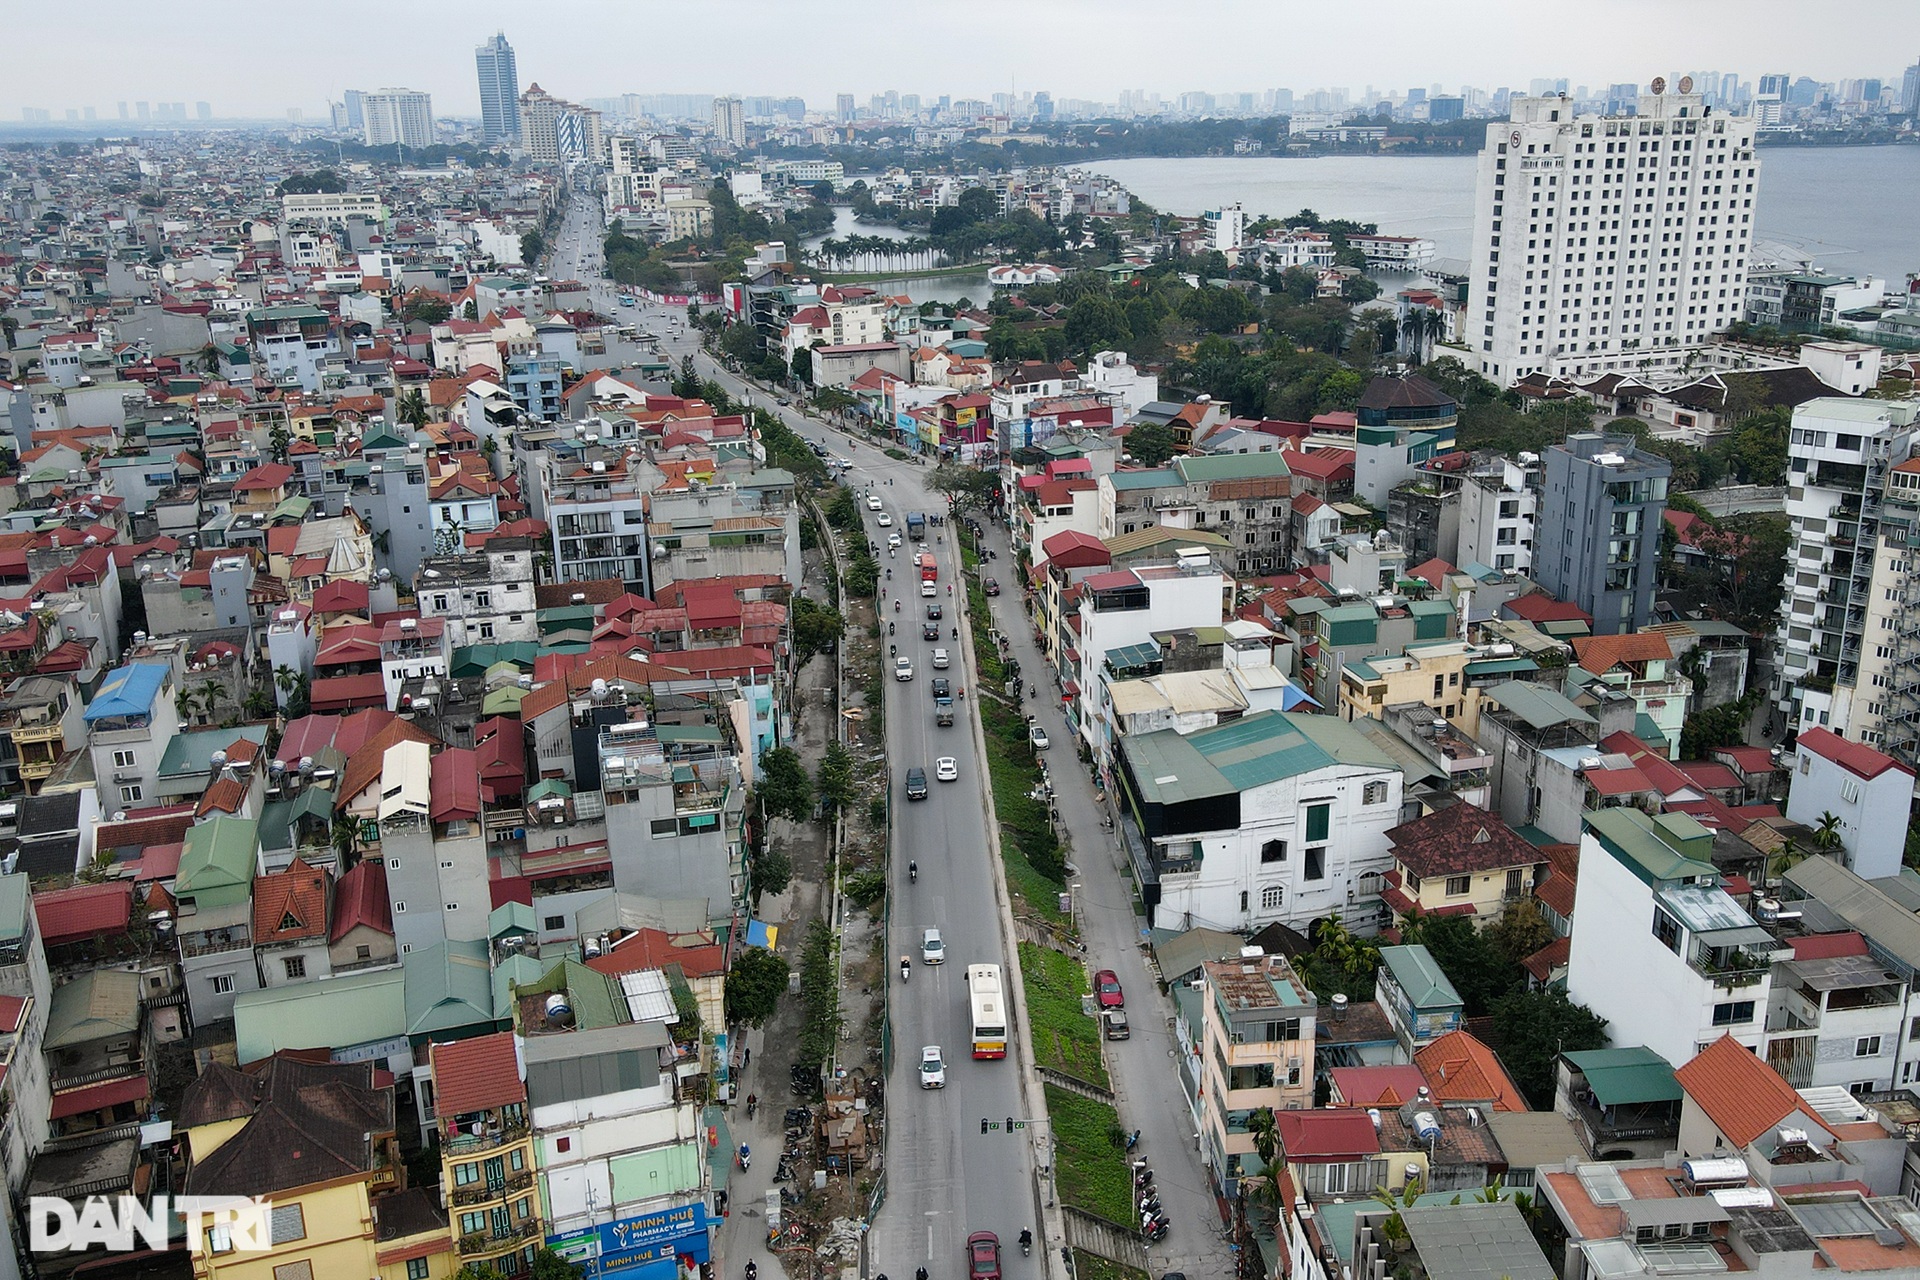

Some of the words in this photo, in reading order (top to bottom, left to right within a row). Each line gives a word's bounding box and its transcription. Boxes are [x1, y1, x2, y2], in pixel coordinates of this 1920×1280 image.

[631, 1215, 665, 1231] MINH
[632, 1224, 675, 1239] PHARMACY
[606, 1256, 632, 1268] MINH
